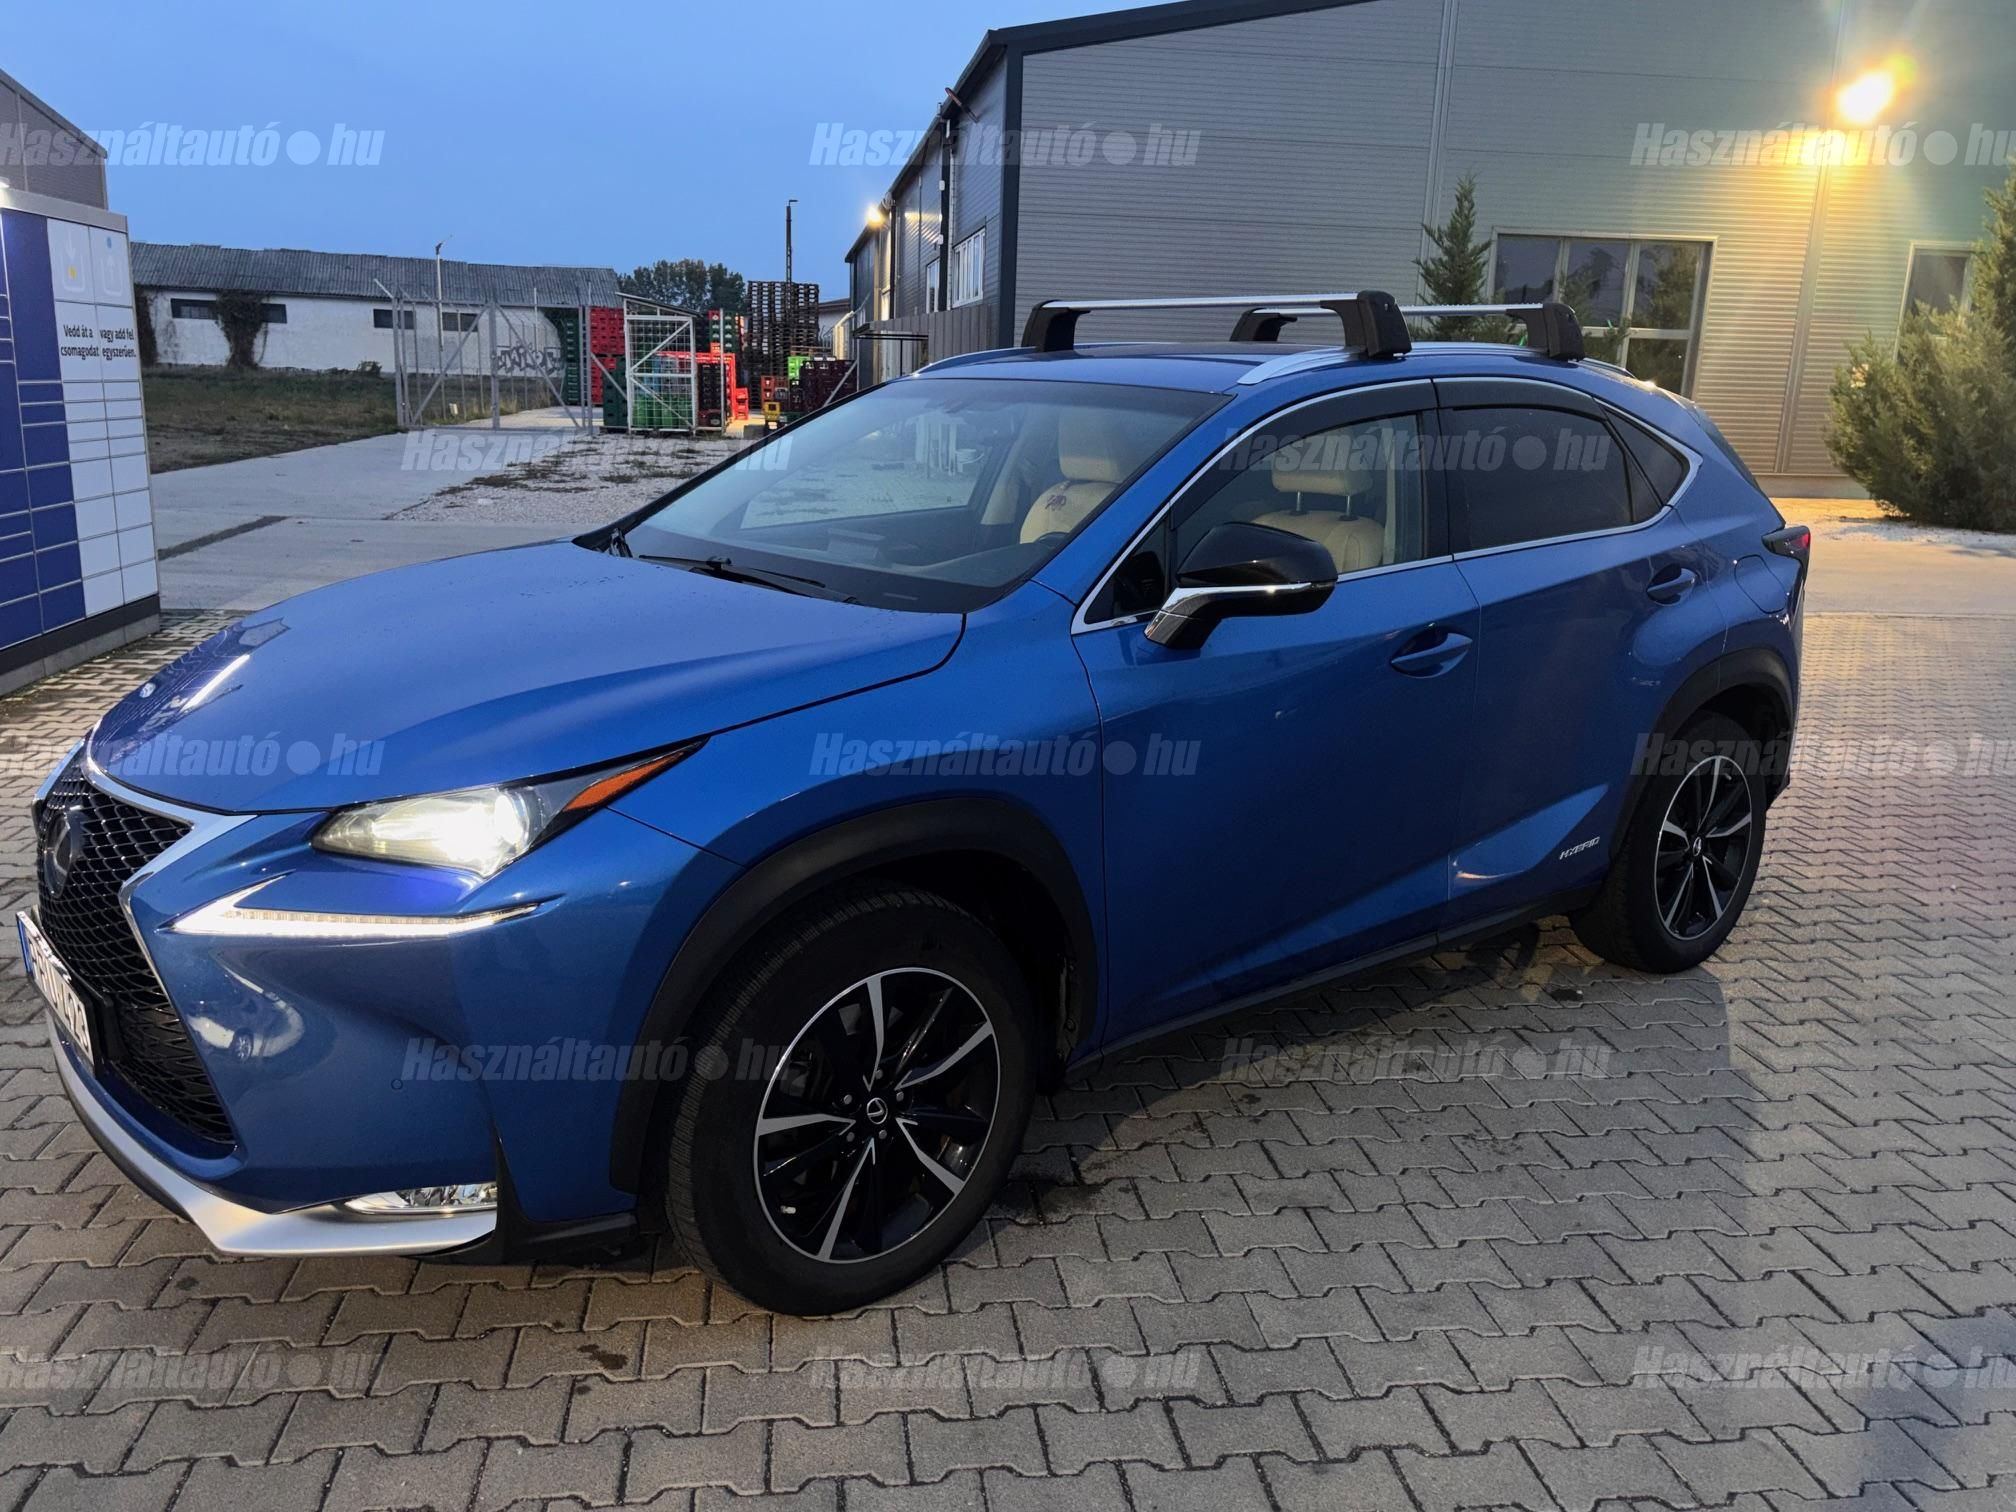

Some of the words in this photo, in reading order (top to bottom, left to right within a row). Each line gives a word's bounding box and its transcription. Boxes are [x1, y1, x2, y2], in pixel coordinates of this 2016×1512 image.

[63, 324, 81, 338] Vedd
[99, 329, 114, 343] vagy
[115, 328, 126, 340] add
